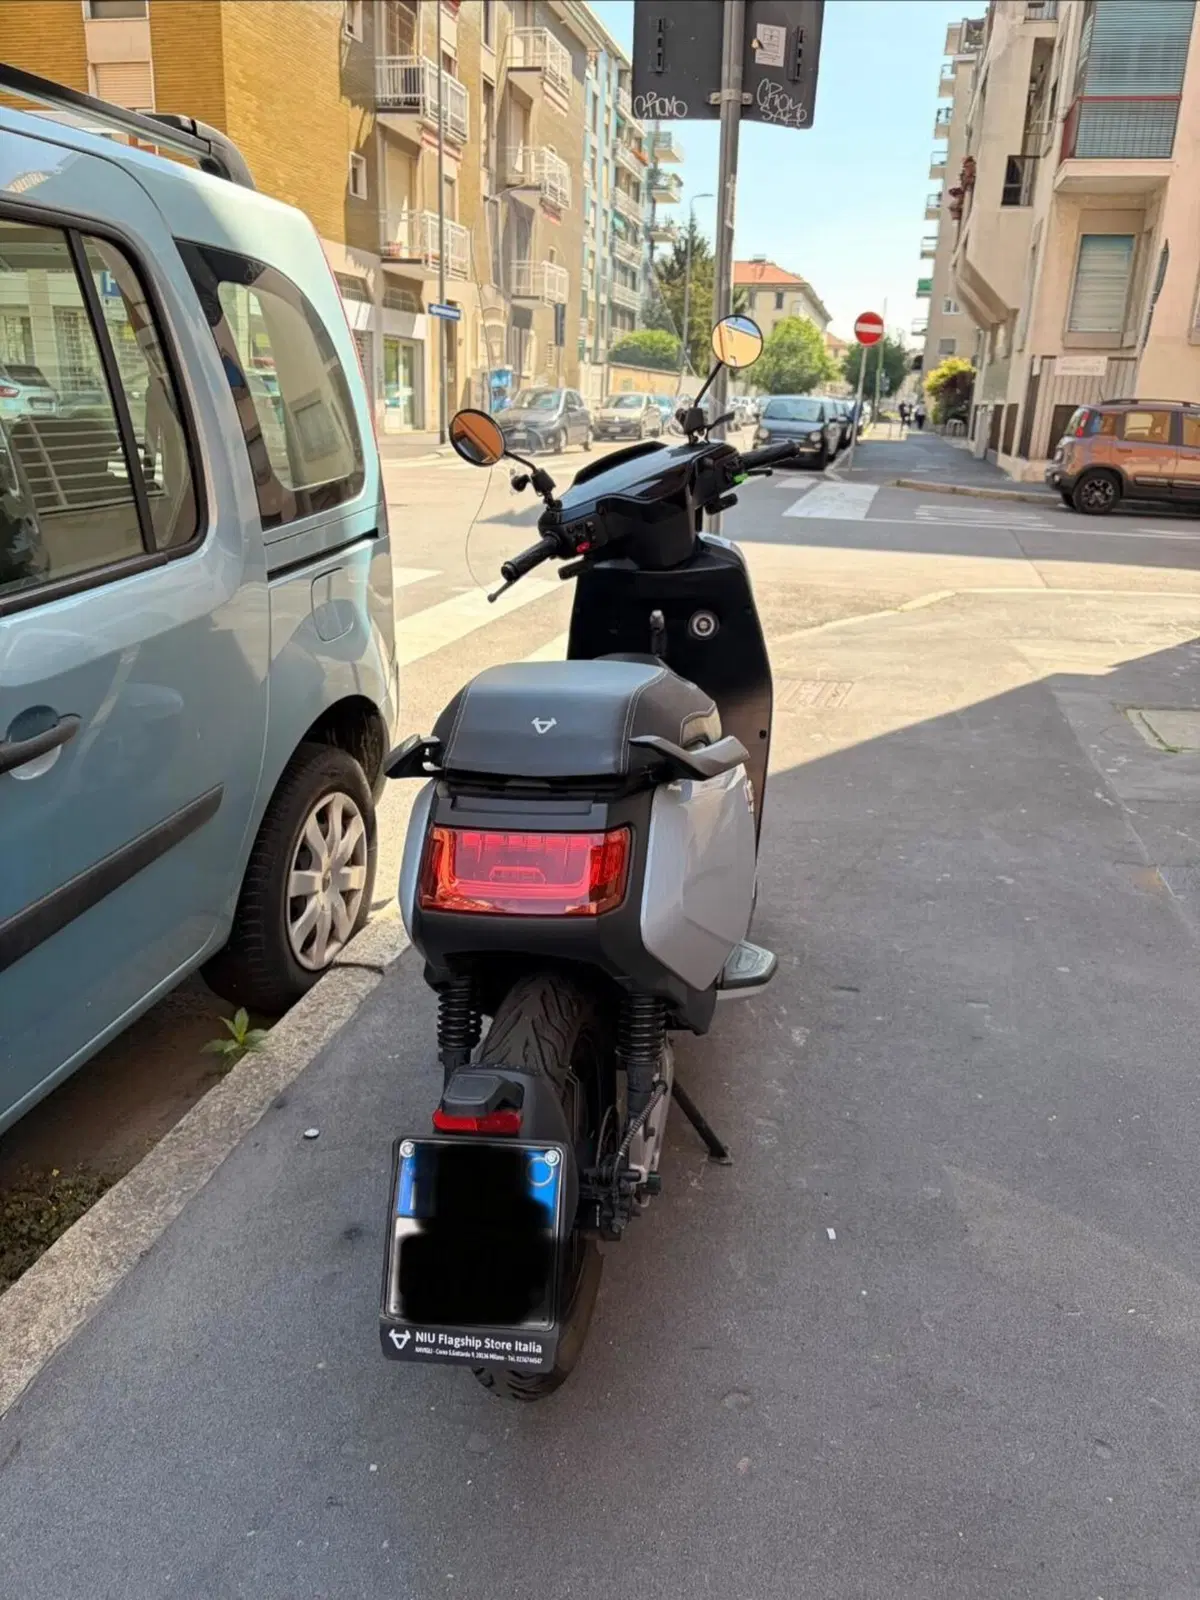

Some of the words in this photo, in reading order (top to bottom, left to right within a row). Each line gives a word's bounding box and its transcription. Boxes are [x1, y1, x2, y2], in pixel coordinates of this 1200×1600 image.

[415, 1331, 436, 1344] NIU
[438, 1333, 482, 1351] Flagship
[484, 1337, 512, 1351] Store
[514, 1340, 543, 1354] Italia
